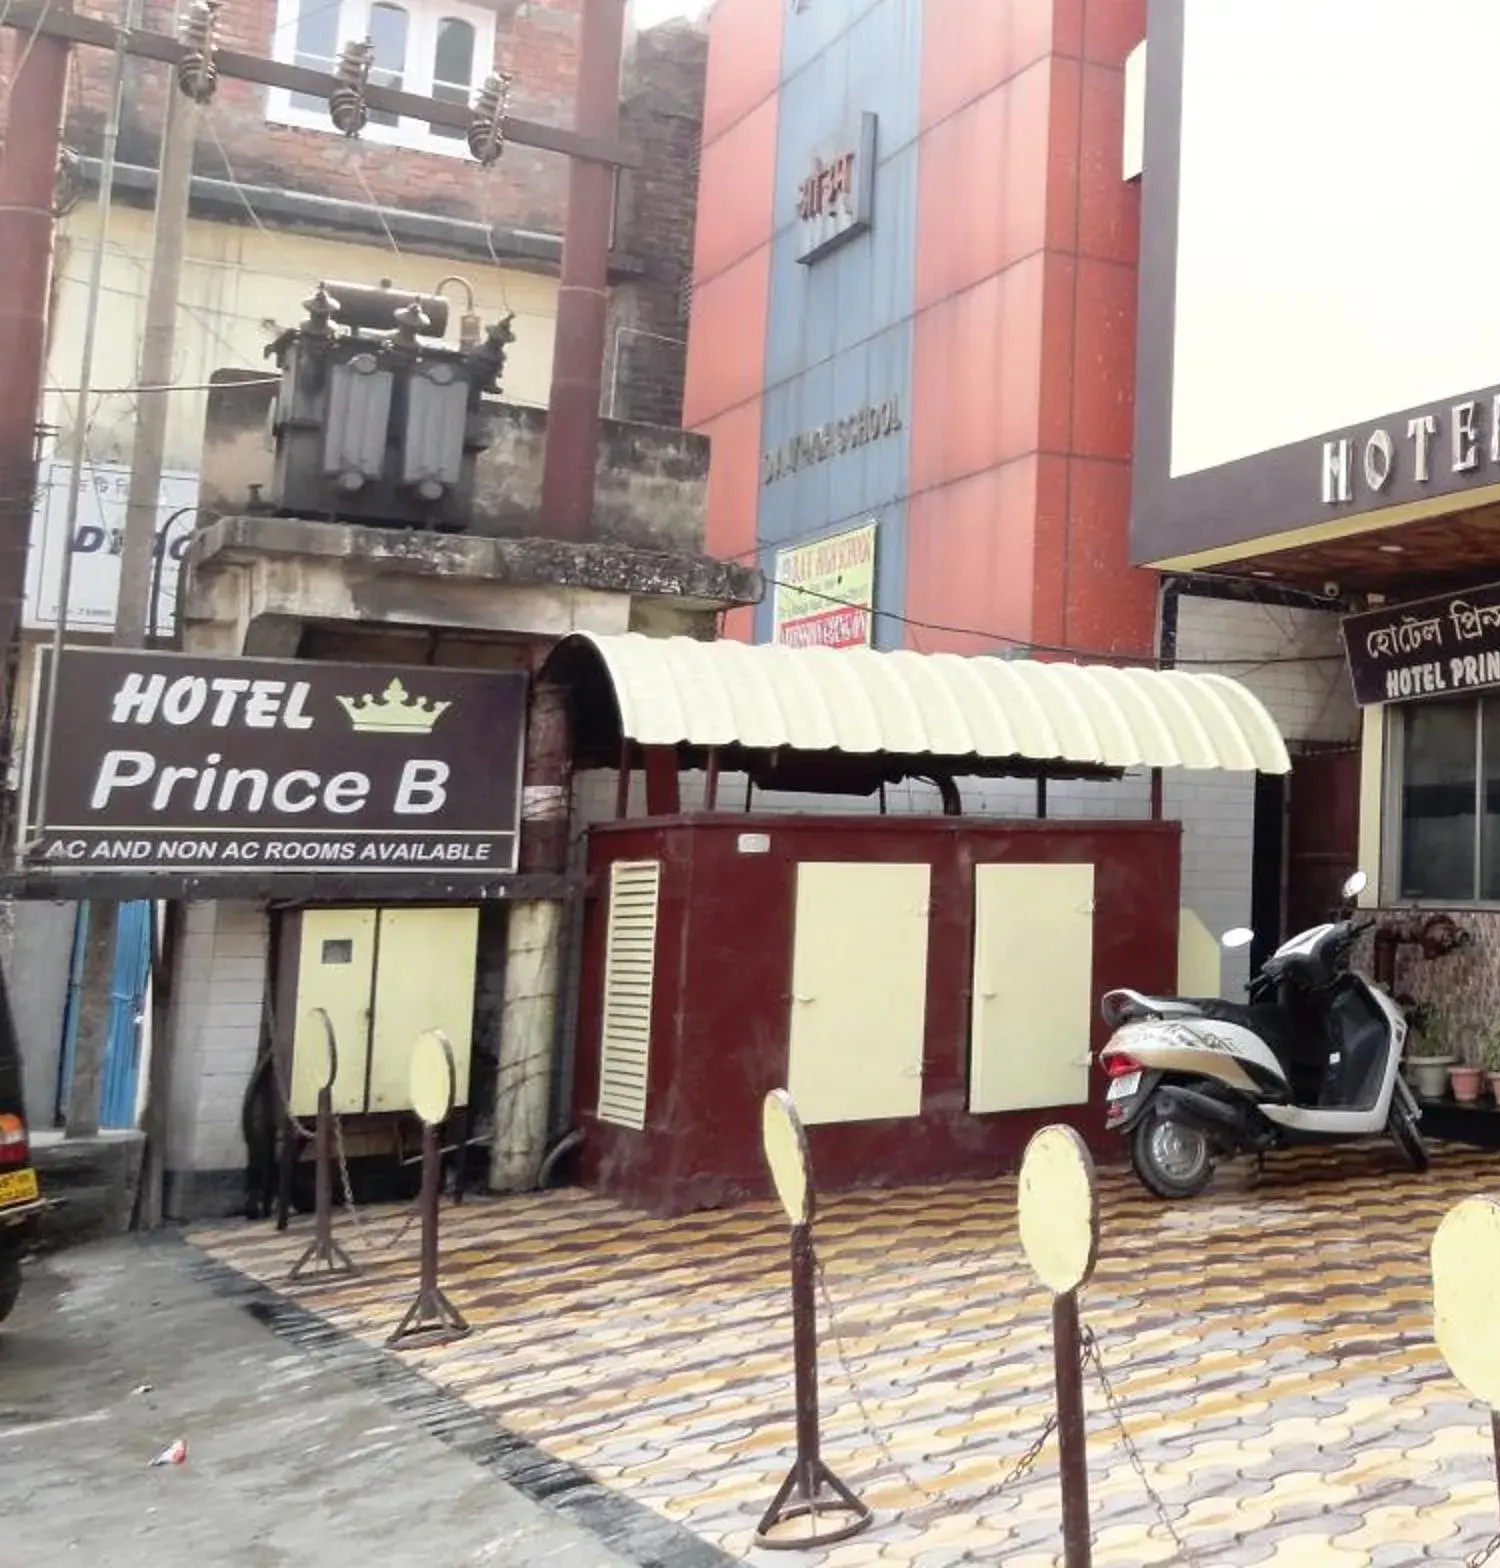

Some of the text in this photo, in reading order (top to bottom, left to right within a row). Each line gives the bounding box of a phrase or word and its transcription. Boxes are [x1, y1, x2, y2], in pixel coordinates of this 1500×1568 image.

[1366, 615, 1443, 659] হোটেল
[110, 672, 315, 730] HOTEL
[1385, 662, 1446, 698] HOTEL
[90, 749, 451, 815] Prince B
[46, 840, 493, 862] AC AND NON AC ROOMS AVAILABLE
